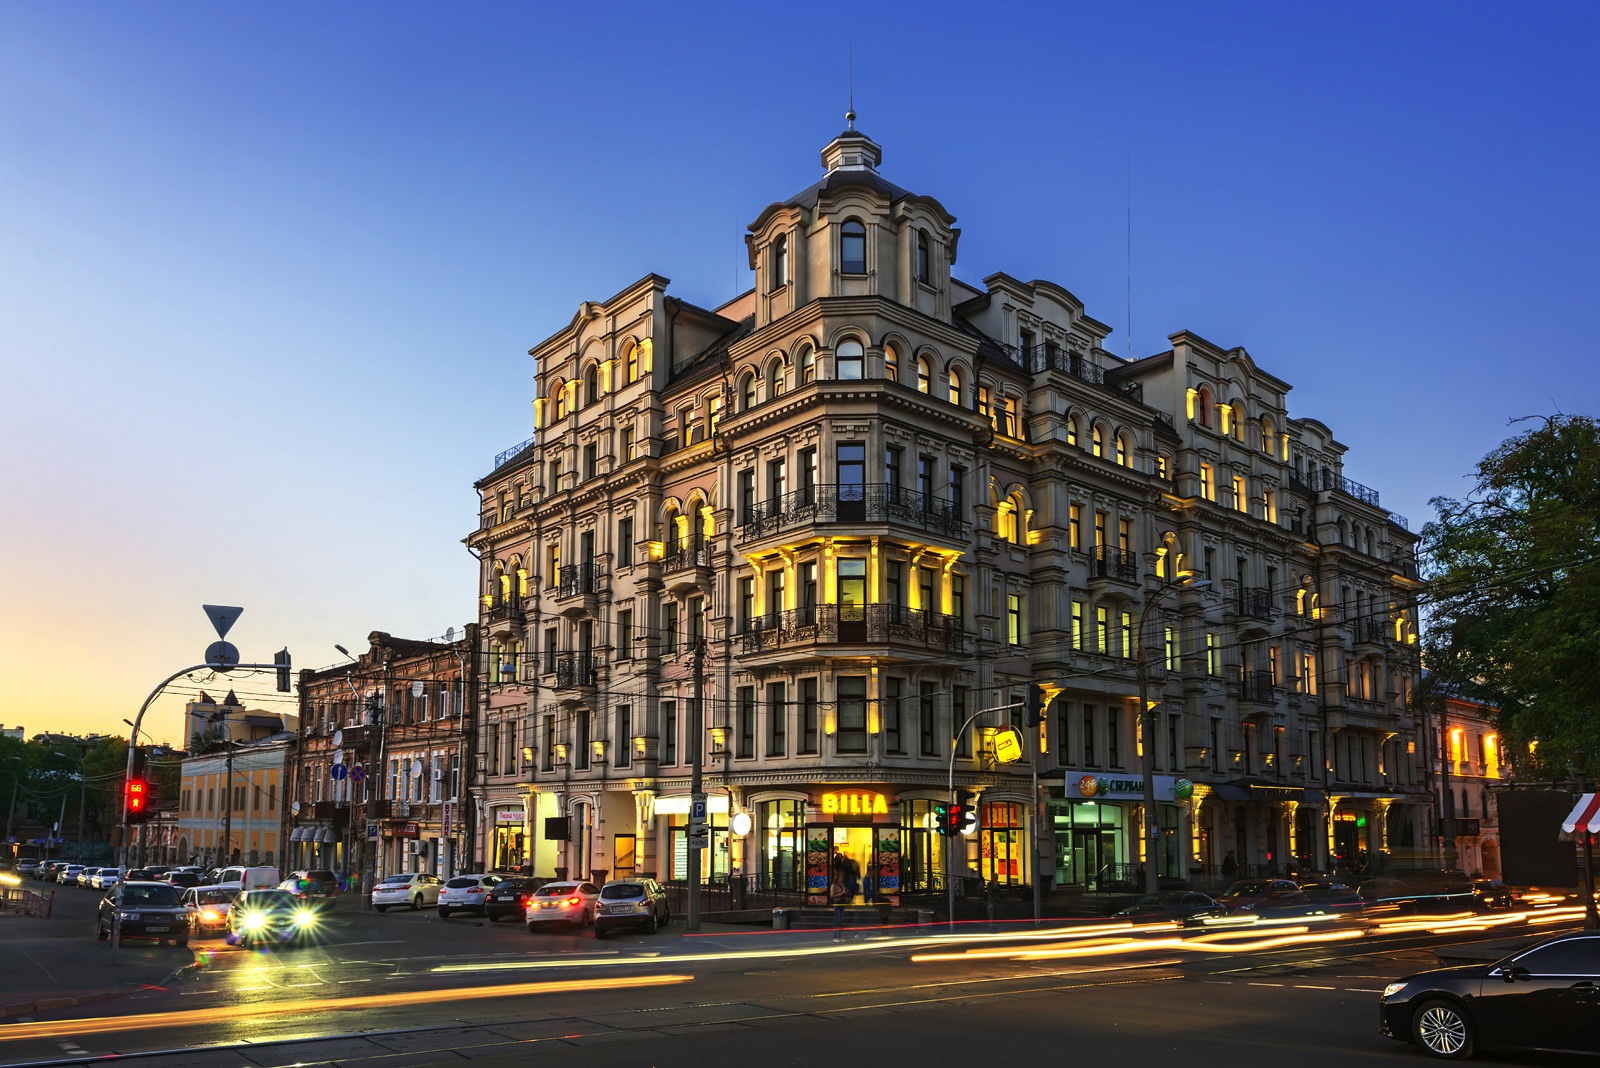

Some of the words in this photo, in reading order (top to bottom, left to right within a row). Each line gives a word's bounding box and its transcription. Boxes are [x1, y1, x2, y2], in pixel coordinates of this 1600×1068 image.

[1080, 779, 1090, 789] 24
[1110, 779, 1144, 792] СБЕРБАН
[822, 794, 888, 814] BILLA
